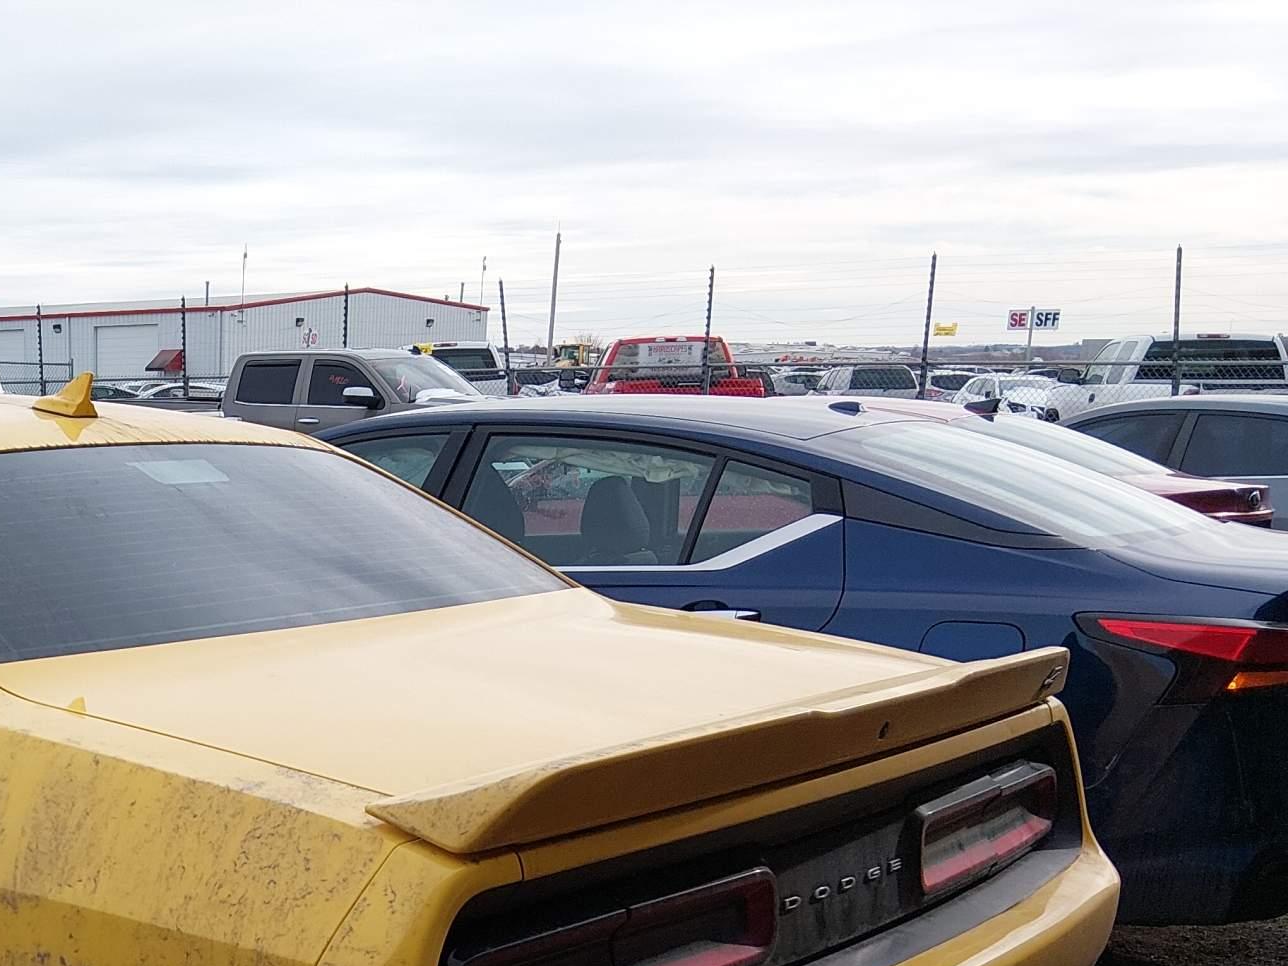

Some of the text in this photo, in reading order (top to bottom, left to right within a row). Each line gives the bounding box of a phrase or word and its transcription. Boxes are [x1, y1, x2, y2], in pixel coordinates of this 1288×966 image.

[1009, 312, 1061, 328] SE SFF
[783, 858, 903, 911] DODGE
